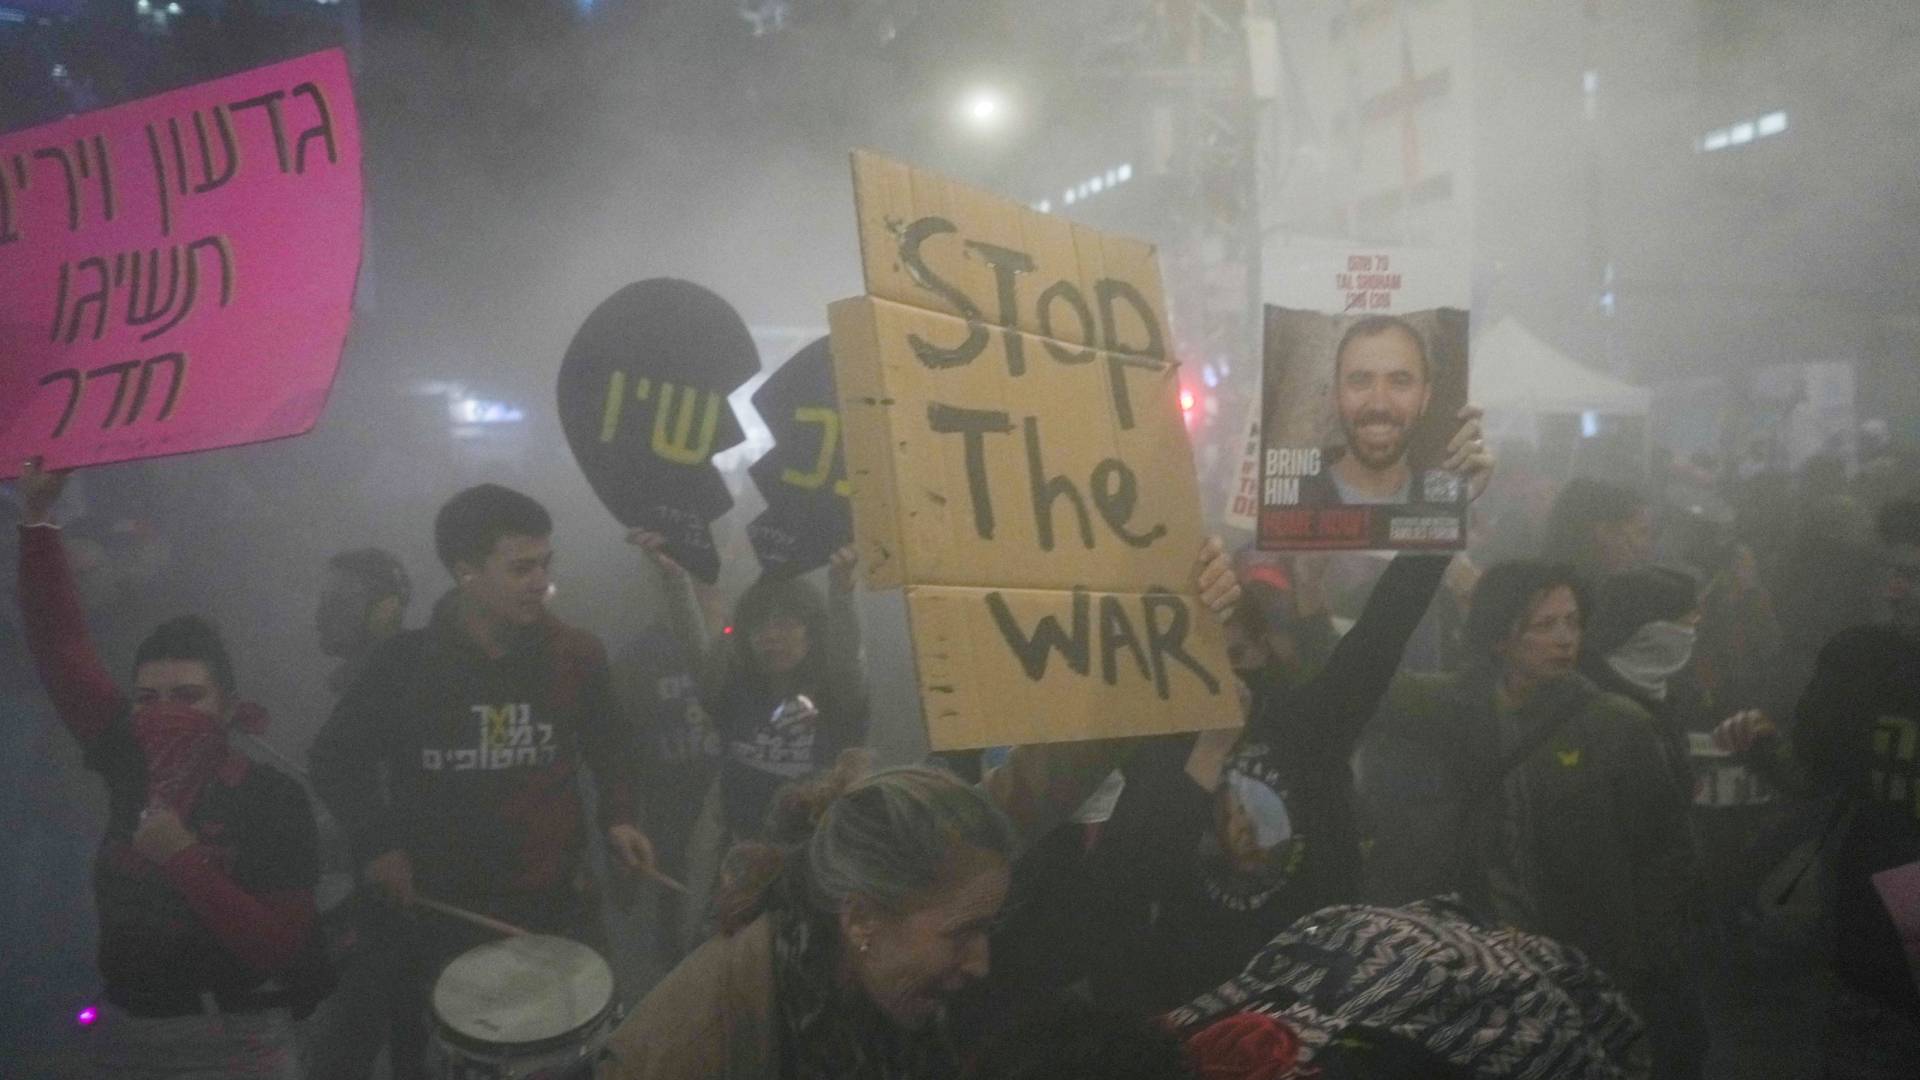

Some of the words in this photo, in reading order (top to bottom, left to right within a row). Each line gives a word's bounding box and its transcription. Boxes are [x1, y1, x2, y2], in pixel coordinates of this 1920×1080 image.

[145, 81, 338, 237] גדעון
[51, 233, 235, 345] תשיגו
[38, 351, 188, 439] חדר
[927, 403, 1167, 552] The
[1264, 477, 1300, 505] HIM
[1265, 448, 1322, 477] BRING
[984, 584, 1221, 700] WAR
